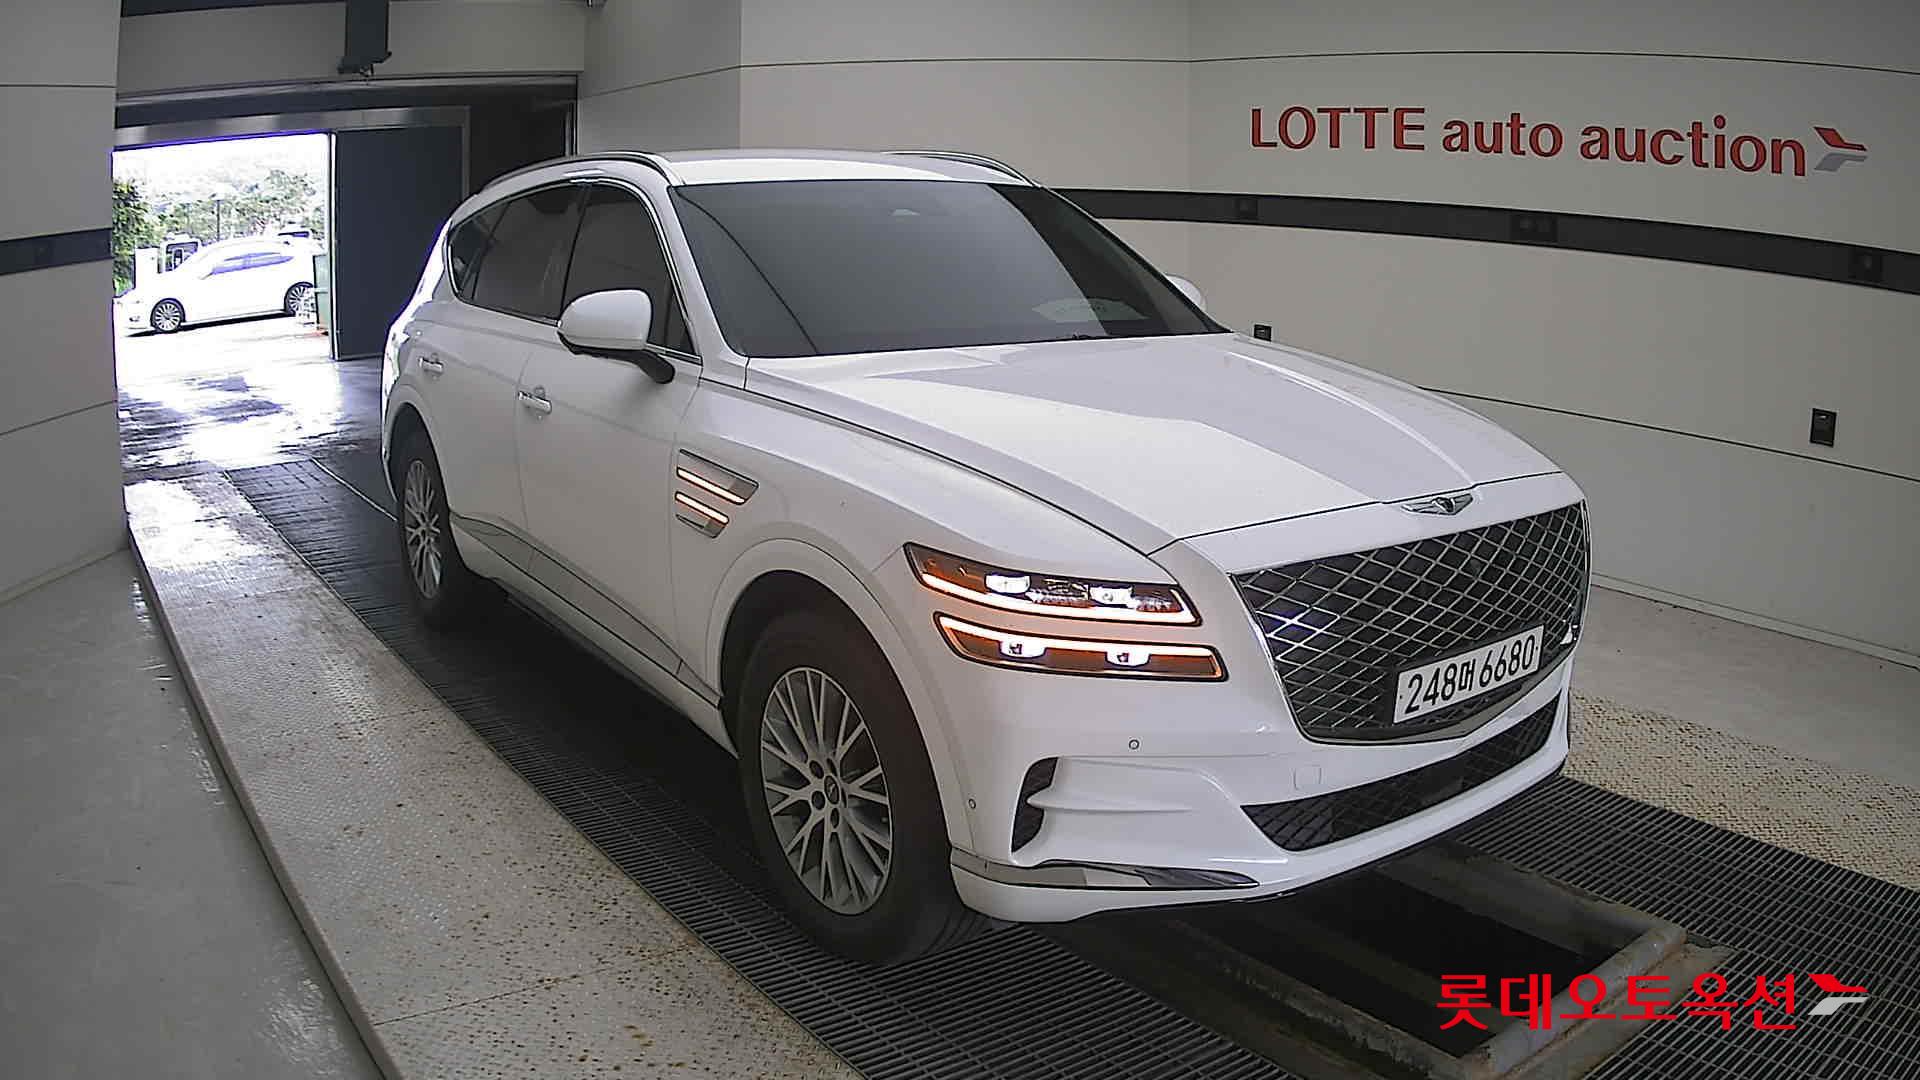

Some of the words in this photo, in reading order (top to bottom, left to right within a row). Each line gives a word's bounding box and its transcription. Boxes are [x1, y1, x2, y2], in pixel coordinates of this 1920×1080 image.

[1251, 107, 1424, 150] LOTTE
[1442, 112, 1563, 156] auto
[1579, 115, 1806, 176] auction
[1479, 635, 1535, 687] 6680
